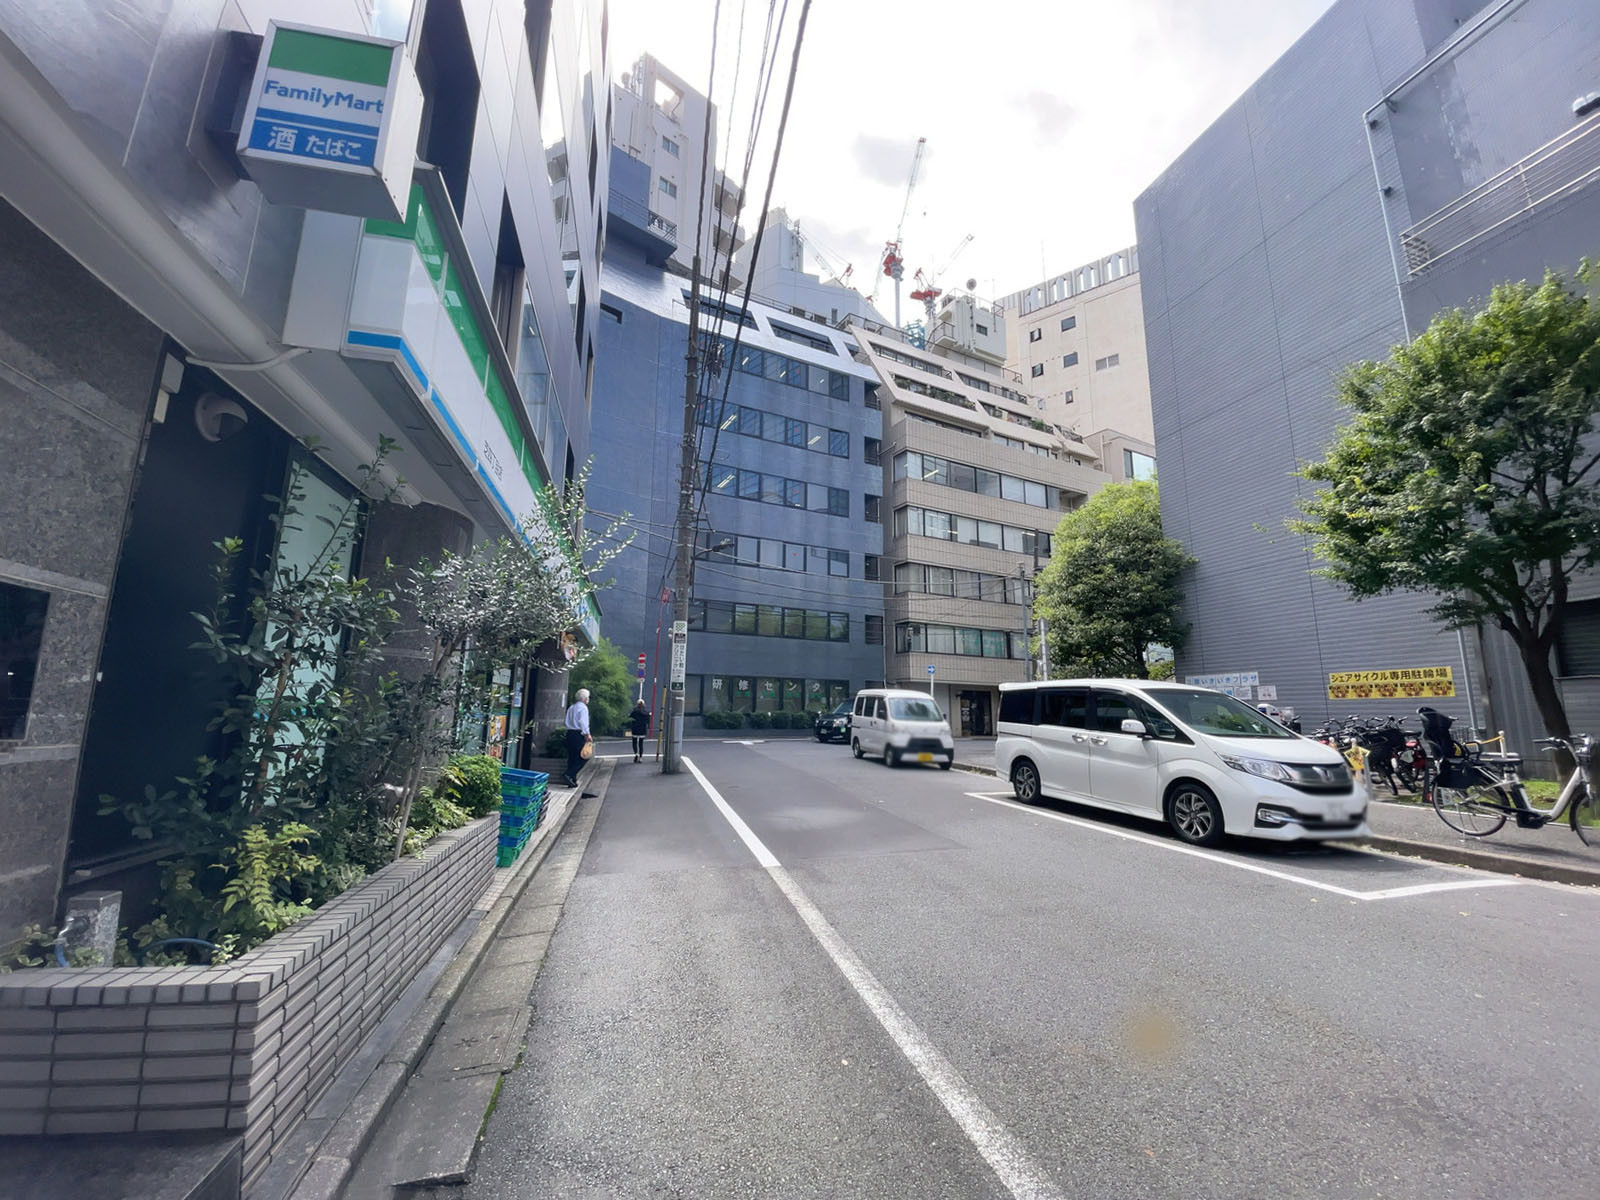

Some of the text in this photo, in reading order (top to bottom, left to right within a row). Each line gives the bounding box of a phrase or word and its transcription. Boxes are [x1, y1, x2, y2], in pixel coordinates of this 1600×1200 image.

[264, 80, 384, 113] FamilyMart
[267, 126, 362, 160] 酒 たばこ
[712, 678, 843, 692] 研修センター
[1330, 668, 1448, 683] シェアサイクル専用駐輪場
